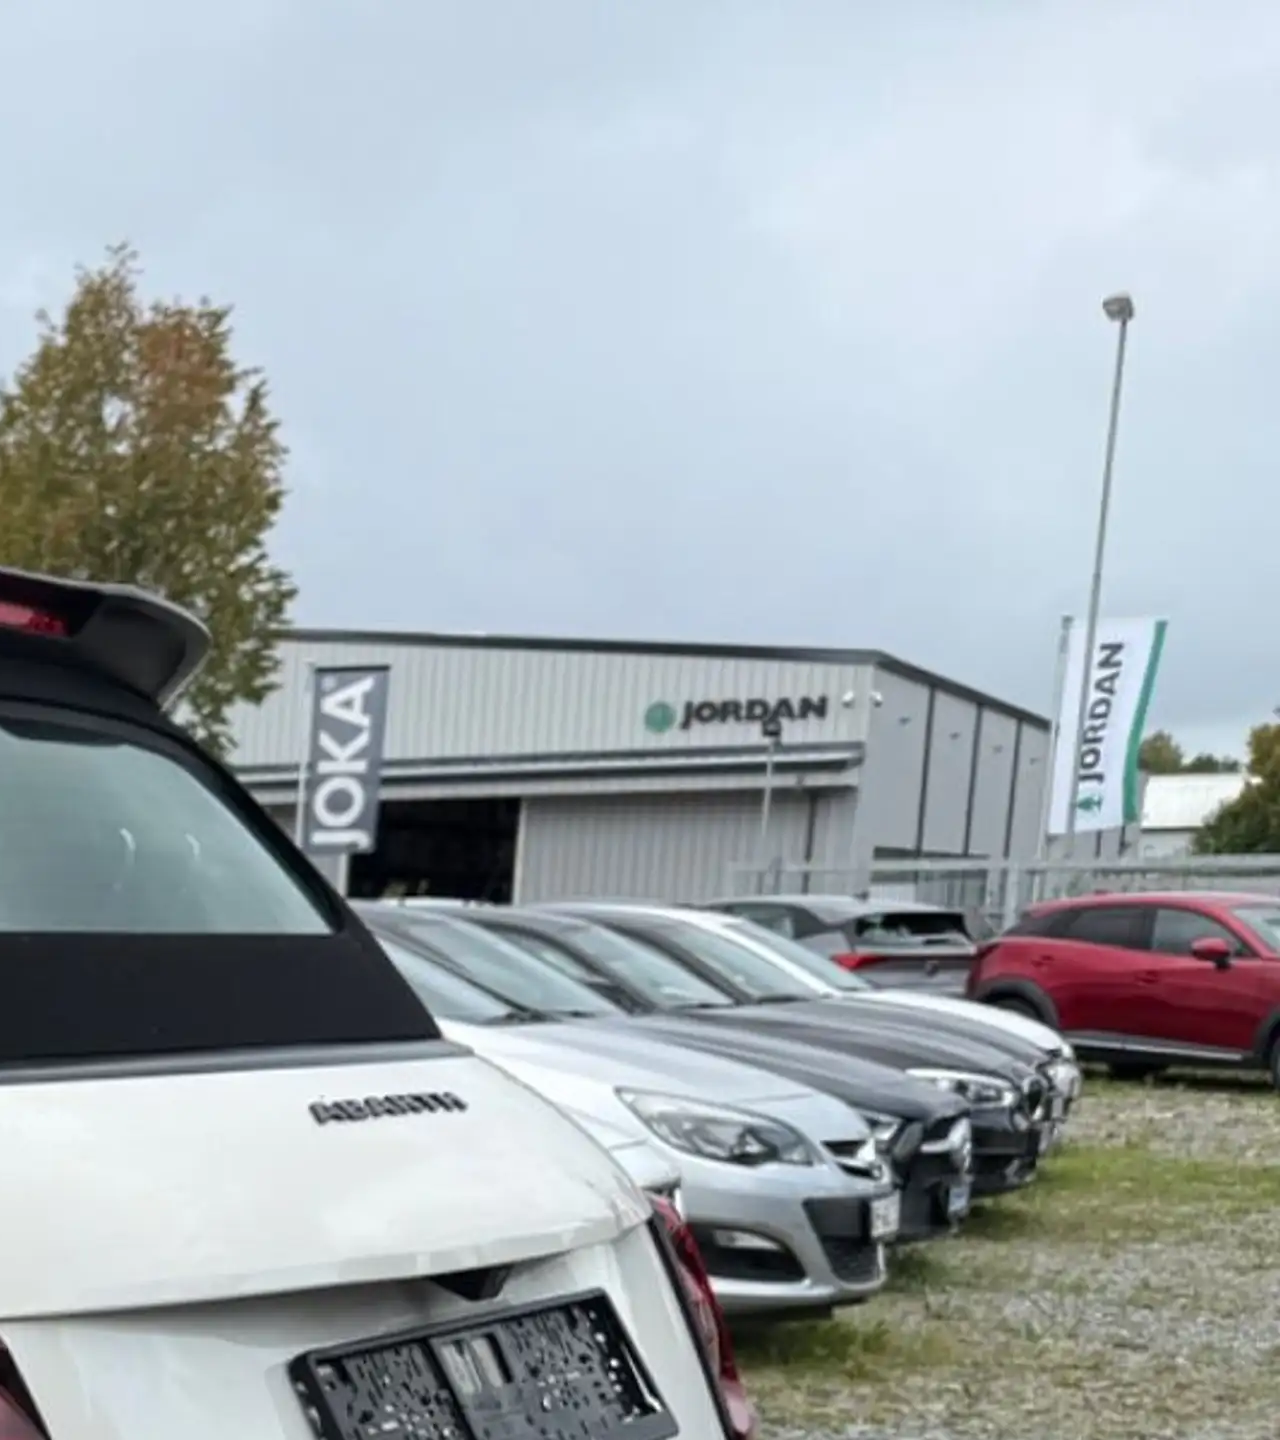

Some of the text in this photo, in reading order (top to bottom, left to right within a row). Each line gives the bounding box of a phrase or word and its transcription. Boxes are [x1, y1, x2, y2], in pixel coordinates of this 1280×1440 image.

[680, 695, 829, 730] JORDAN
[1078, 642, 1124, 785] JORDAN
[310, 676, 375, 851] JOKA
[308, 1091, 469, 1127] ABARTH
